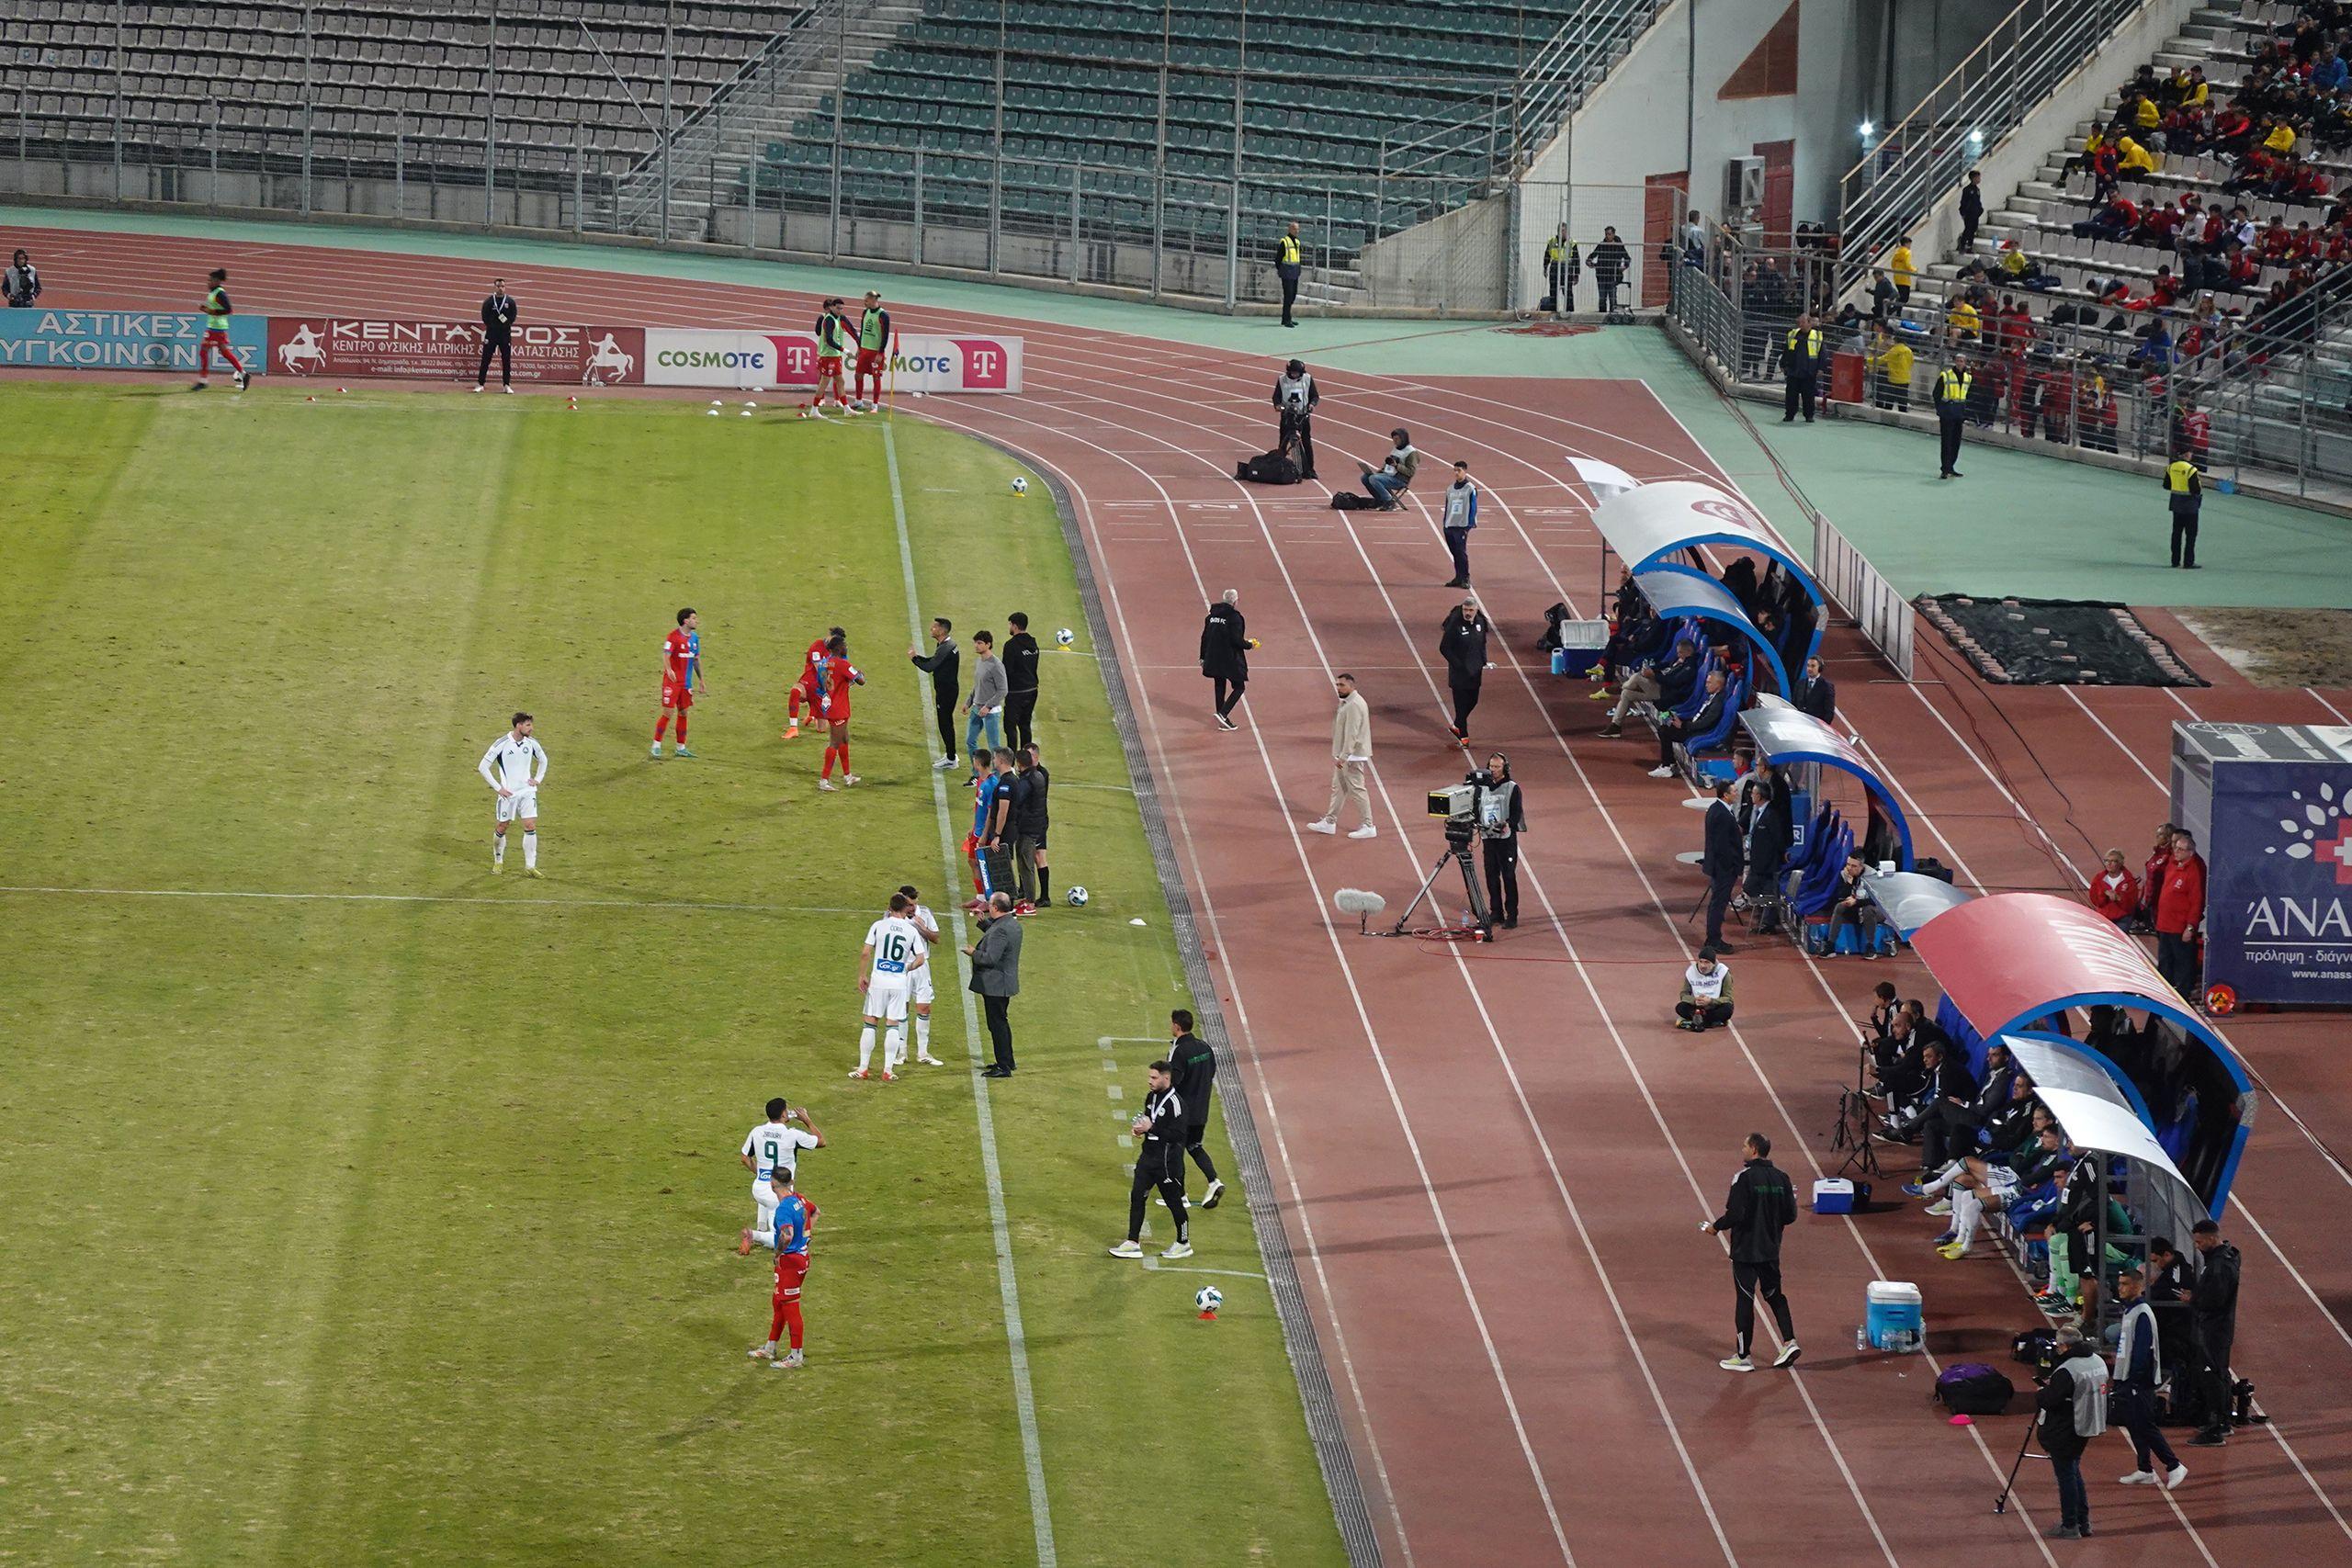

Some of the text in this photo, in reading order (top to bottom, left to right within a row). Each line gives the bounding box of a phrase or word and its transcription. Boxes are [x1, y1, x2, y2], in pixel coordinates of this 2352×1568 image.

[36, 312, 198, 339] ΑΣΤΙΚΕΣ
[0, 338, 258, 368] ΥΓΚΟΙΝΩΝΕΣ
[333, 340, 375, 352] ΚΕΝΤΡΟ
[378, 341, 424, 354] ΦΥΣΙΚΗΣ
[426, 343, 475, 355] ΙΑΤΡΙΚΗΣ
[492, 344, 580, 358] ΚΑΤΑΣΤΑΣΗΣ
[658, 350, 764, 369] COSMOTE
[786, 346, 810, 374] T
[844, 354, 951, 374] CMOTE
[973, 350, 997, 378] T
[883, 932, 907, 962] 16
[2245, 949, 2305, 964] πρόληψη
[764, 1141, 778, 1168] 9
